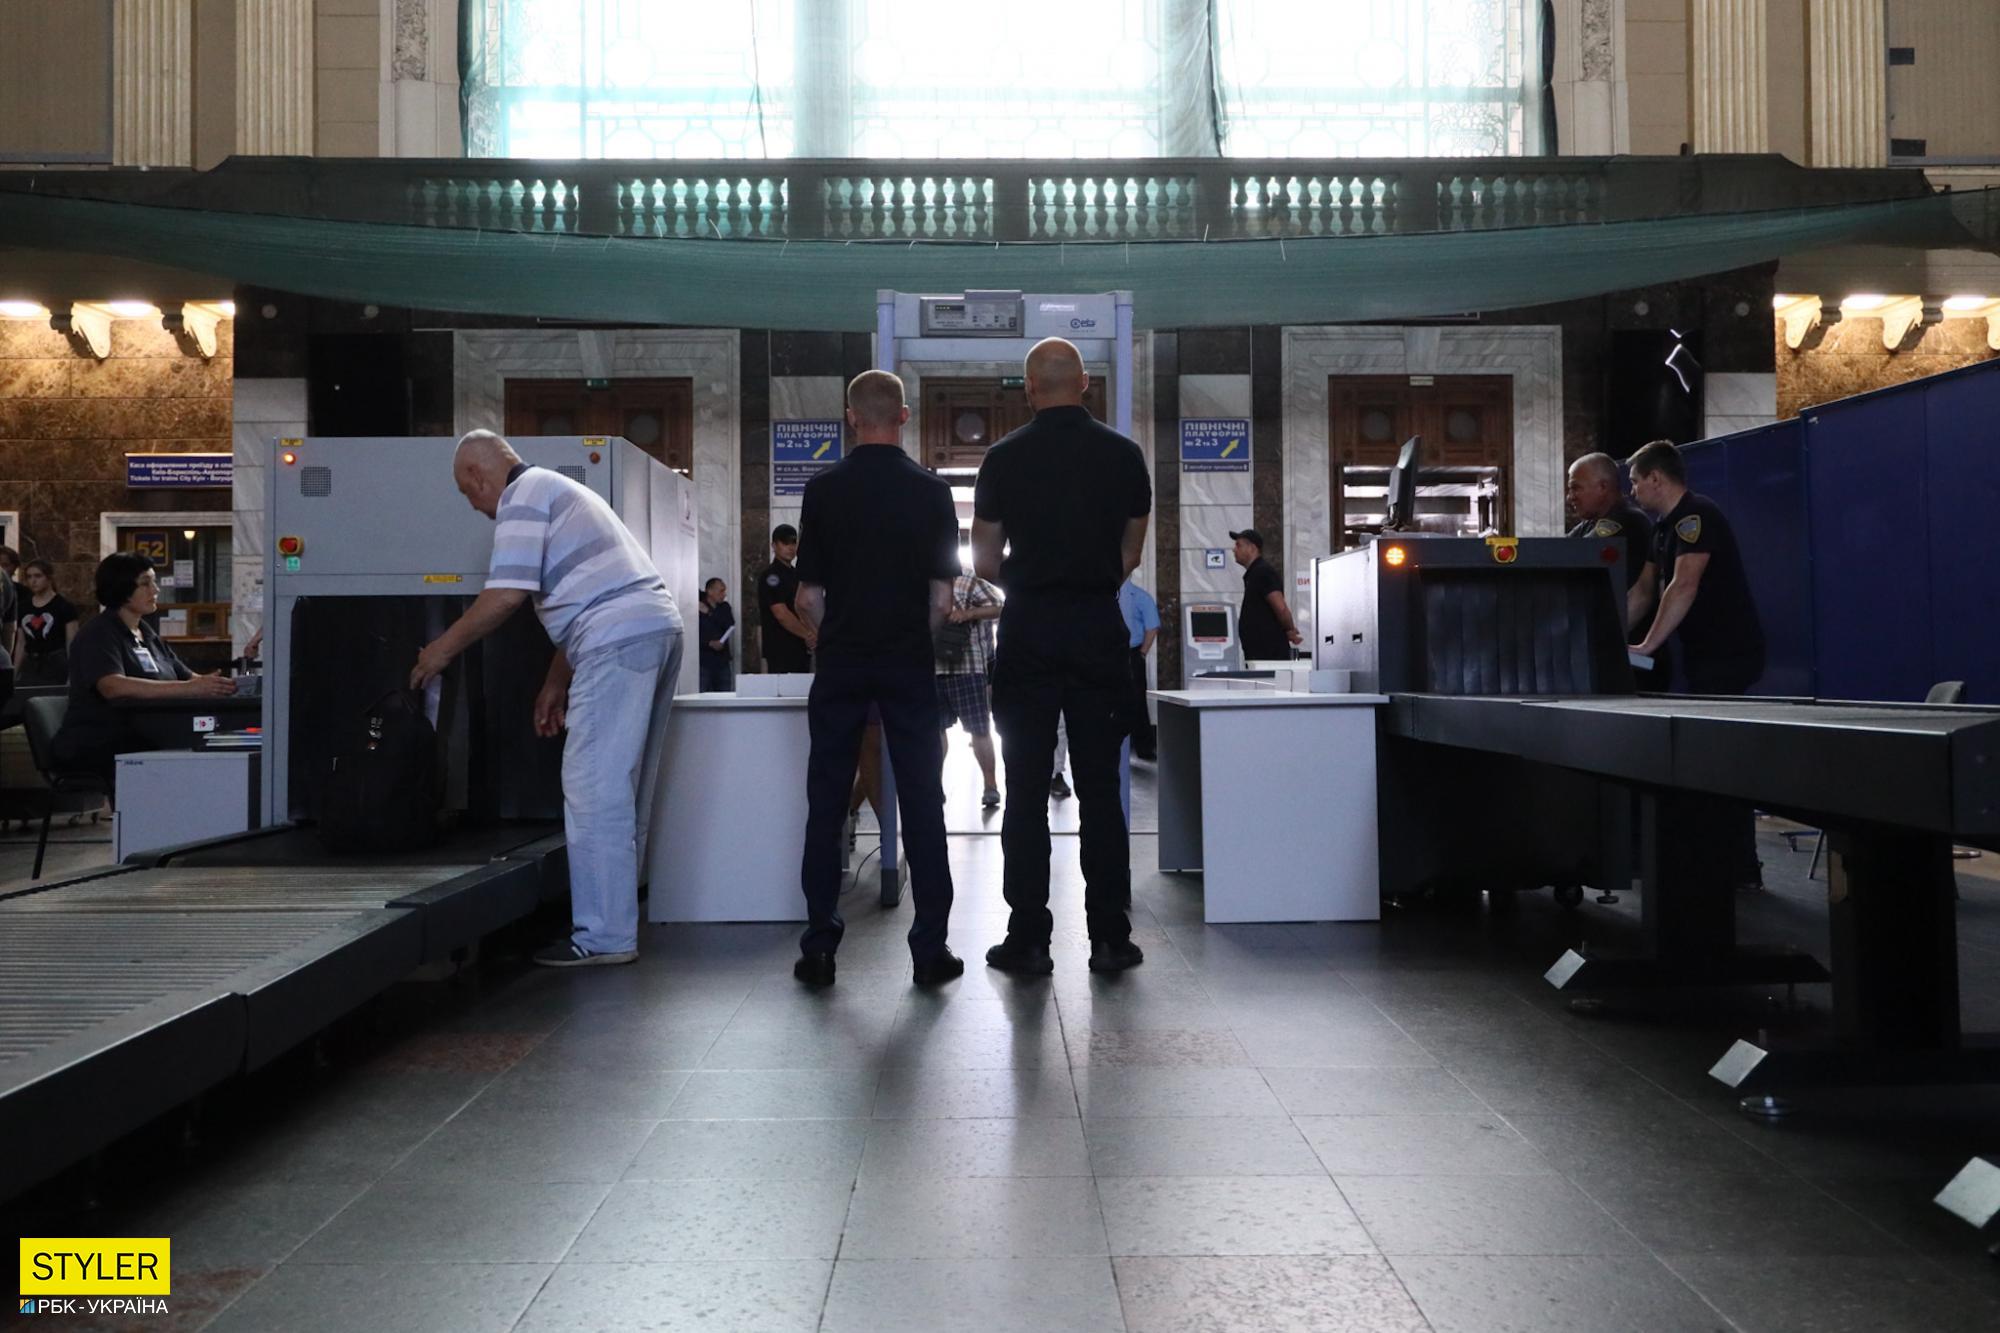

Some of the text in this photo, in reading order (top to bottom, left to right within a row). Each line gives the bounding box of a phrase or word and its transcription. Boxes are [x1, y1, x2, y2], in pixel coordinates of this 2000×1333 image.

[776, 424, 838, 432] ПІВНІЧНІ
[1185, 422, 1245, 430] ПІВНІЧНІ
[787, 440, 793, 448] 2
[803, 440, 810, 448] 3
[1195, 438, 1201, 446] 2
[1211, 438, 1218, 446] 3
[137, 540, 164, 558] 52
